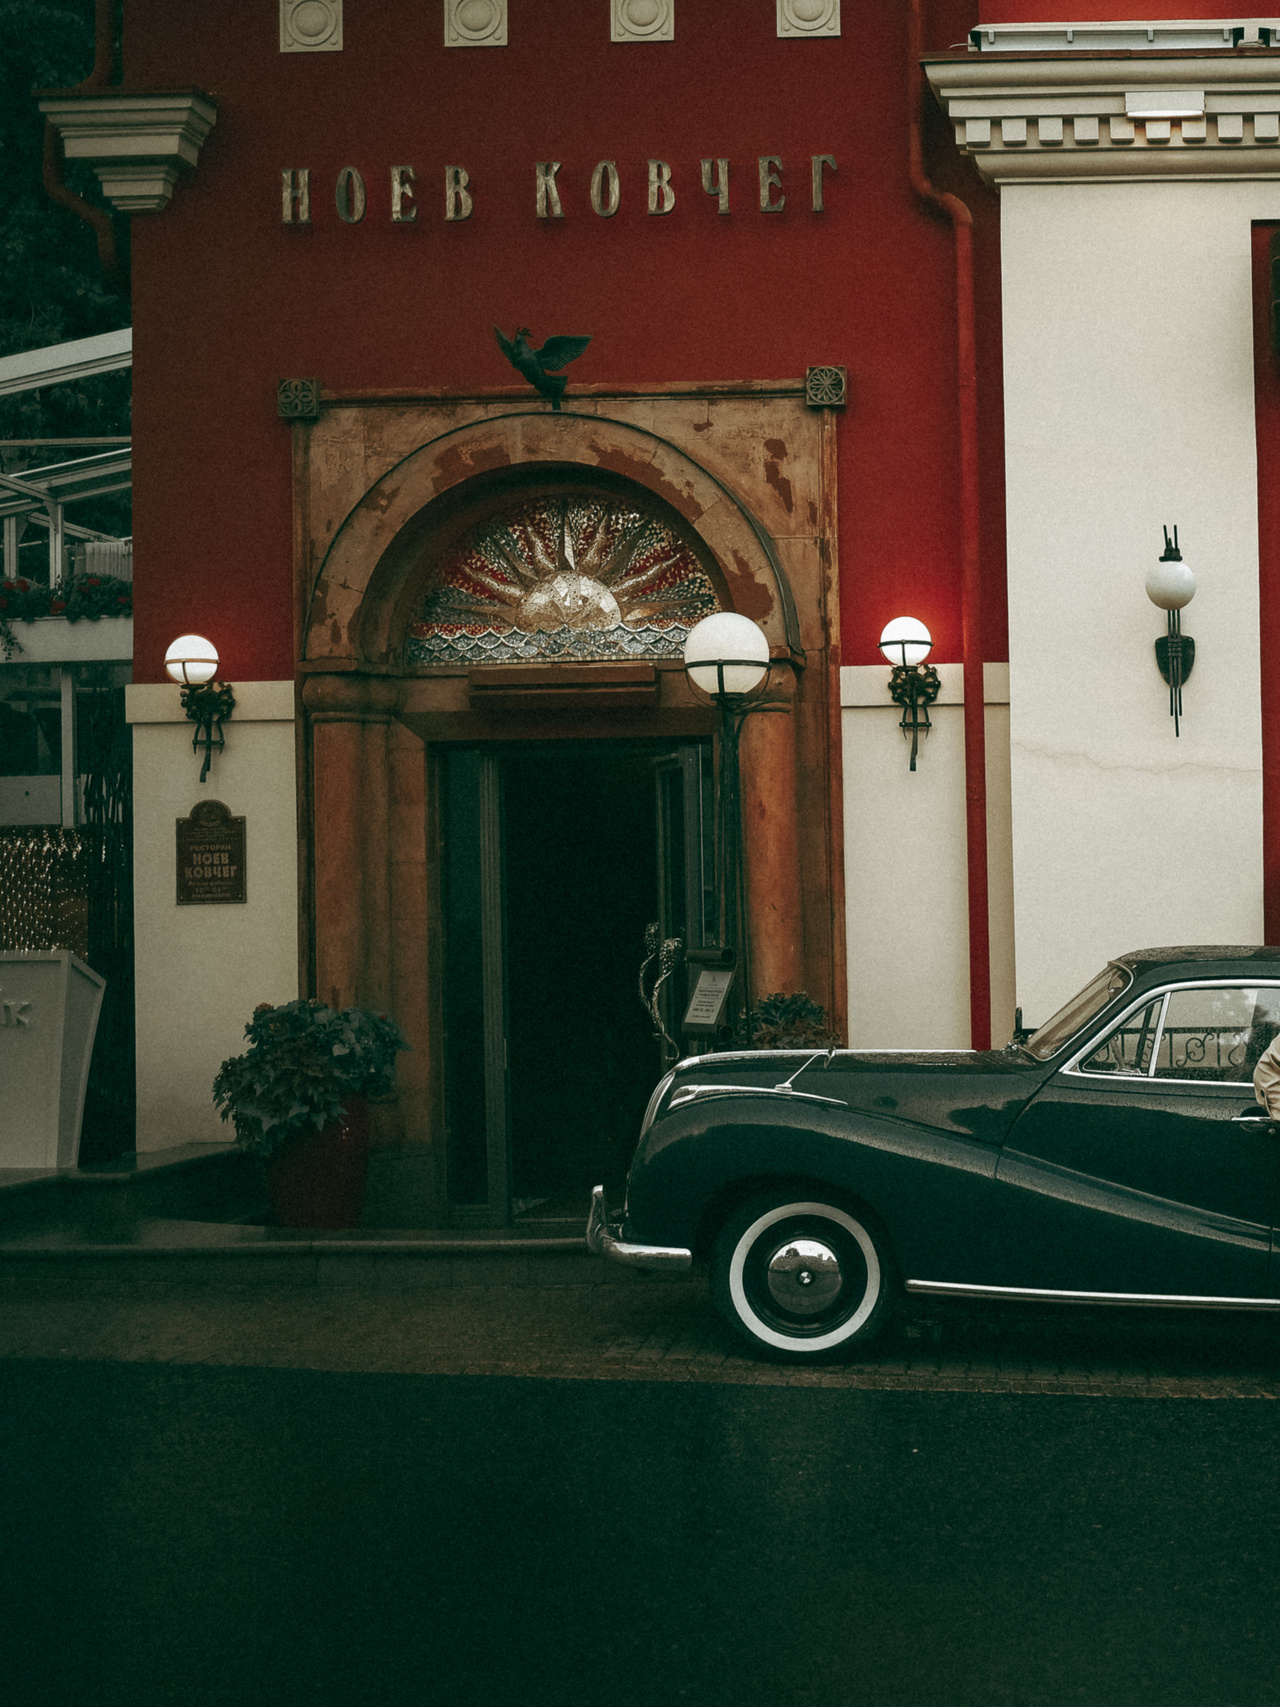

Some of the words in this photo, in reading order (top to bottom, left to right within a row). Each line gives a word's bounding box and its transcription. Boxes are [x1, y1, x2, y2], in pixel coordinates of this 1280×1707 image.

[281, 165, 474, 224] НОЕВ
[535, 154, 837, 219] КОВЧЕГ
[193, 852, 230, 865] НОЕВ
[184, 865, 237, 878] КОВЧЕГ
